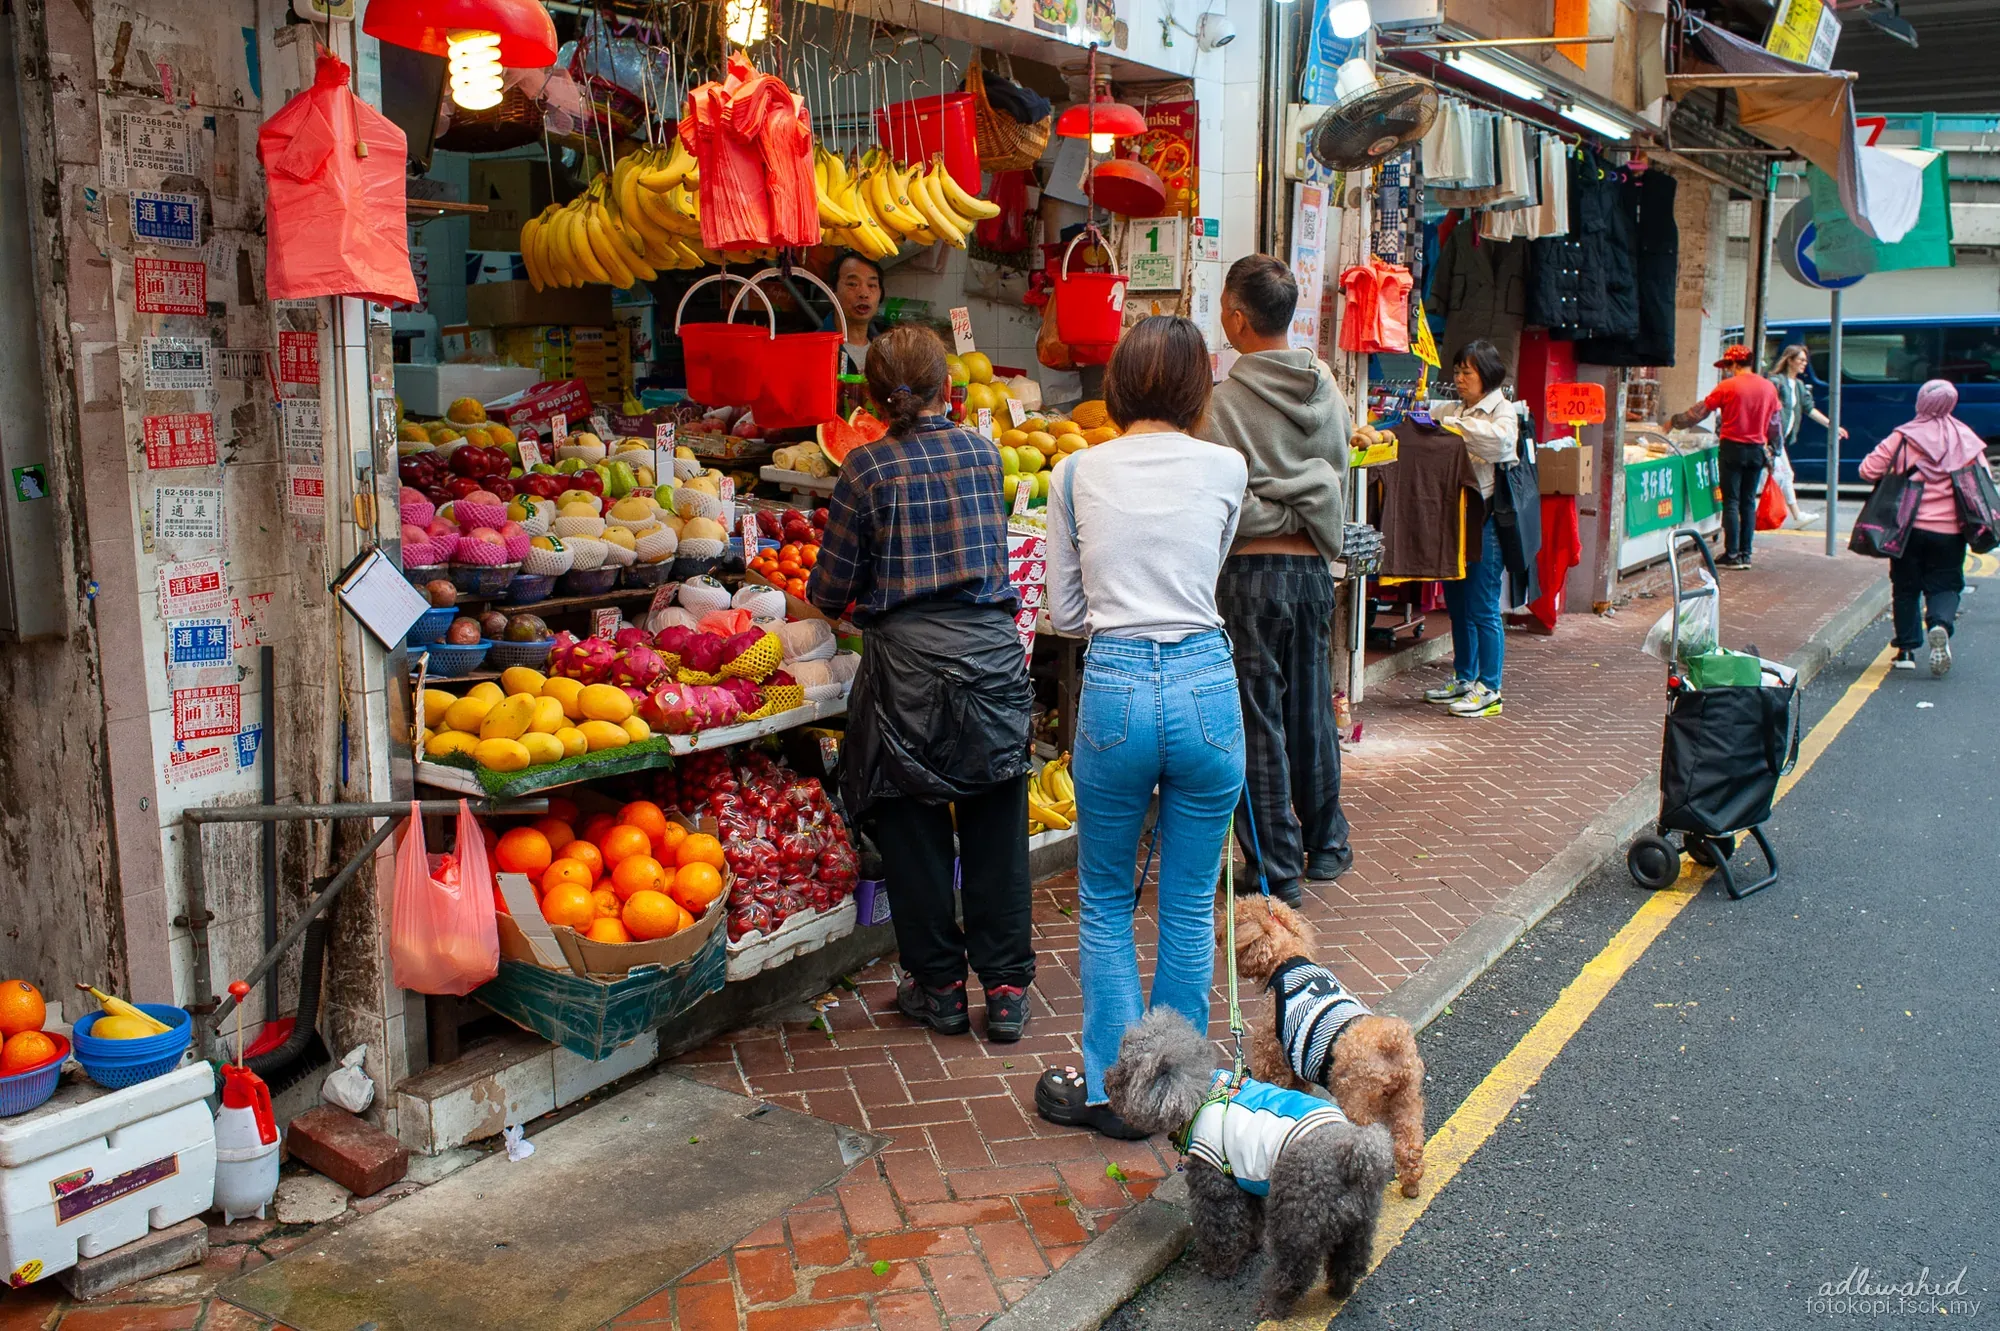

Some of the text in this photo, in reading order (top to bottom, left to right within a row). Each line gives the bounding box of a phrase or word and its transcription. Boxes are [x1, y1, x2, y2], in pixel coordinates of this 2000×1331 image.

[131, 115, 182, 130] 62-568-568
[139, 134, 176, 150] 通渠
[133, 160, 185, 173] 62-568-568
[142, 191, 187, 203] 67913579
[1145, 226, 1159, 253] 1
[953, 320, 970, 336] 48
[154, 352, 203, 369] 通渠王
[537, 389, 581, 411] Papaya
[164, 488, 214, 497] 62-568-568
[171, 504, 207, 518] 通渠
[164, 530, 214, 538] 62-568-568
[174, 560, 209, 572] 68335000
[171, 573, 218, 596] 通渠王
[188, 602, 222, 613] 68335000
[179, 618, 222, 627] 67913579
[177, 629, 193, 648] 通
[207, 627, 224, 646] 渠
[600, 628, 612, 640] 30
[192, 659, 225, 668] 67913579
